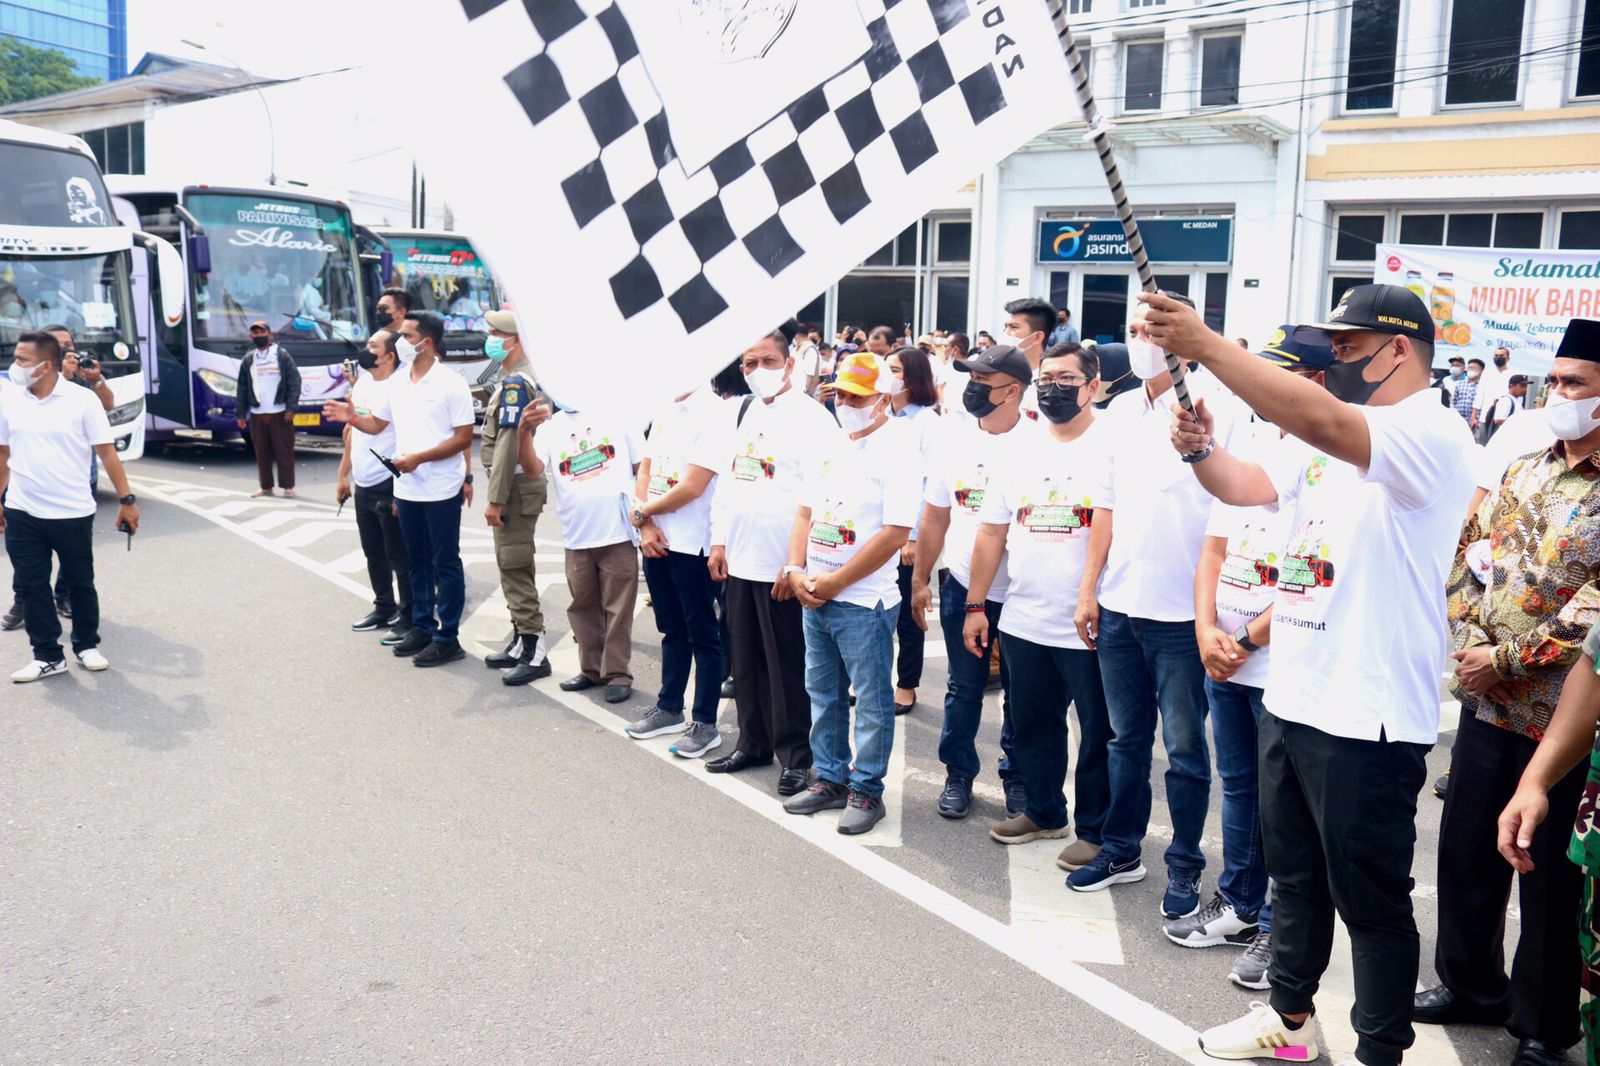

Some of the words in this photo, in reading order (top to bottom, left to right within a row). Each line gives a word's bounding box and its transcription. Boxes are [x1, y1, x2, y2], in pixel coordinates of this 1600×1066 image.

[254, 203, 300, 213] JETBUS
[237, 210, 325, 230] PARIWISATA
[1192, 221, 1218, 229] MEDAN
[1087, 233, 1125, 241] asuransi
[1084, 241, 1134, 258] jasind
[407, 253, 451, 263] JETBUS
[1468, 286, 1541, 316] MUDIK
[1377, 314, 1403, 326] WALIKOTA
[1403, 319, 1419, 330] MEDAN
[1482, 319, 1521, 332] Mudik
